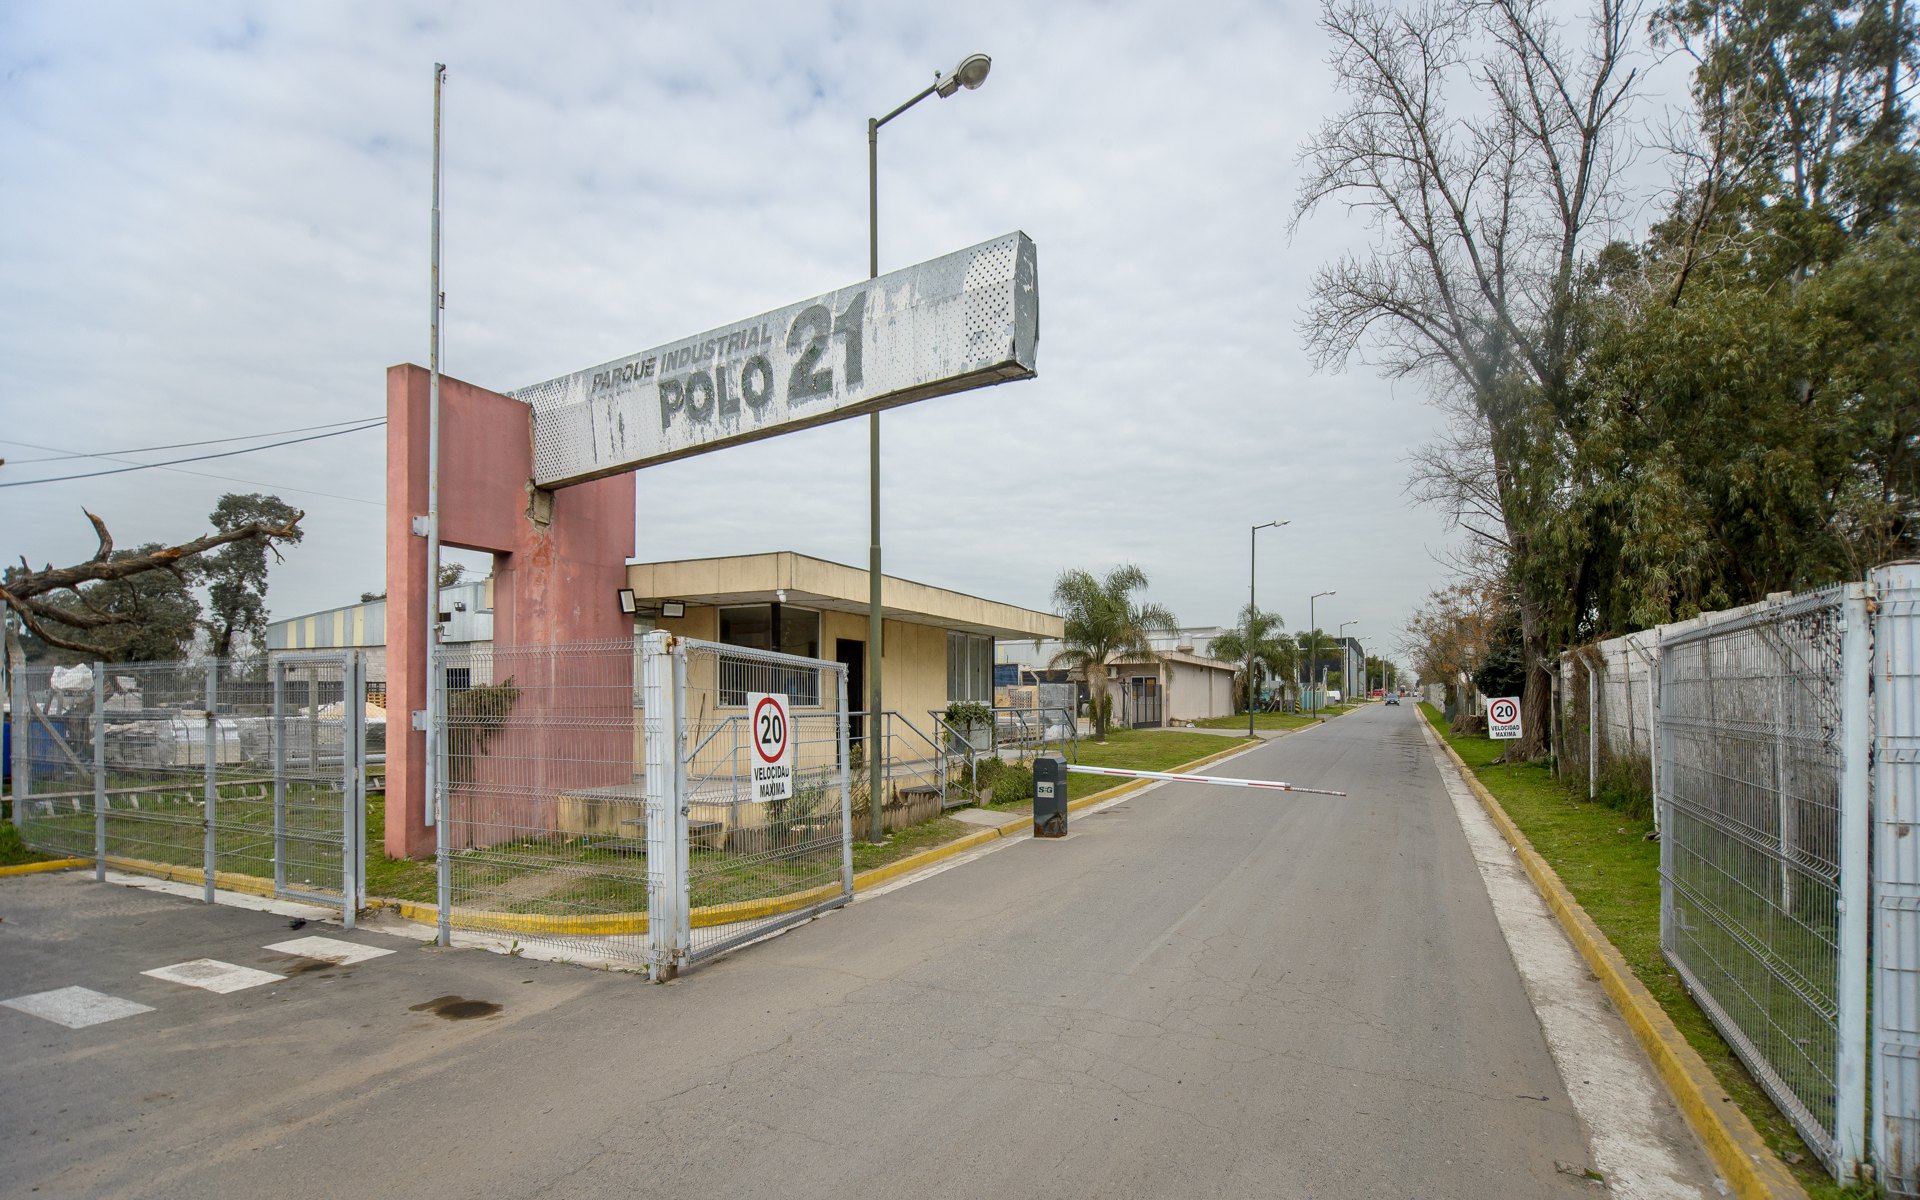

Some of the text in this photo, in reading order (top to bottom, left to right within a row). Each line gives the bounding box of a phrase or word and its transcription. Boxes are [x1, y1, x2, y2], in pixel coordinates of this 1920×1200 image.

[592, 324, 772, 393] PARQUE INDUSTRIAL
[659, 292, 866, 432] POLO 21
[1496, 705, 1513, 717] 20
[761, 715, 782, 744] 20
[760, 782, 786, 797] MAXIMA
